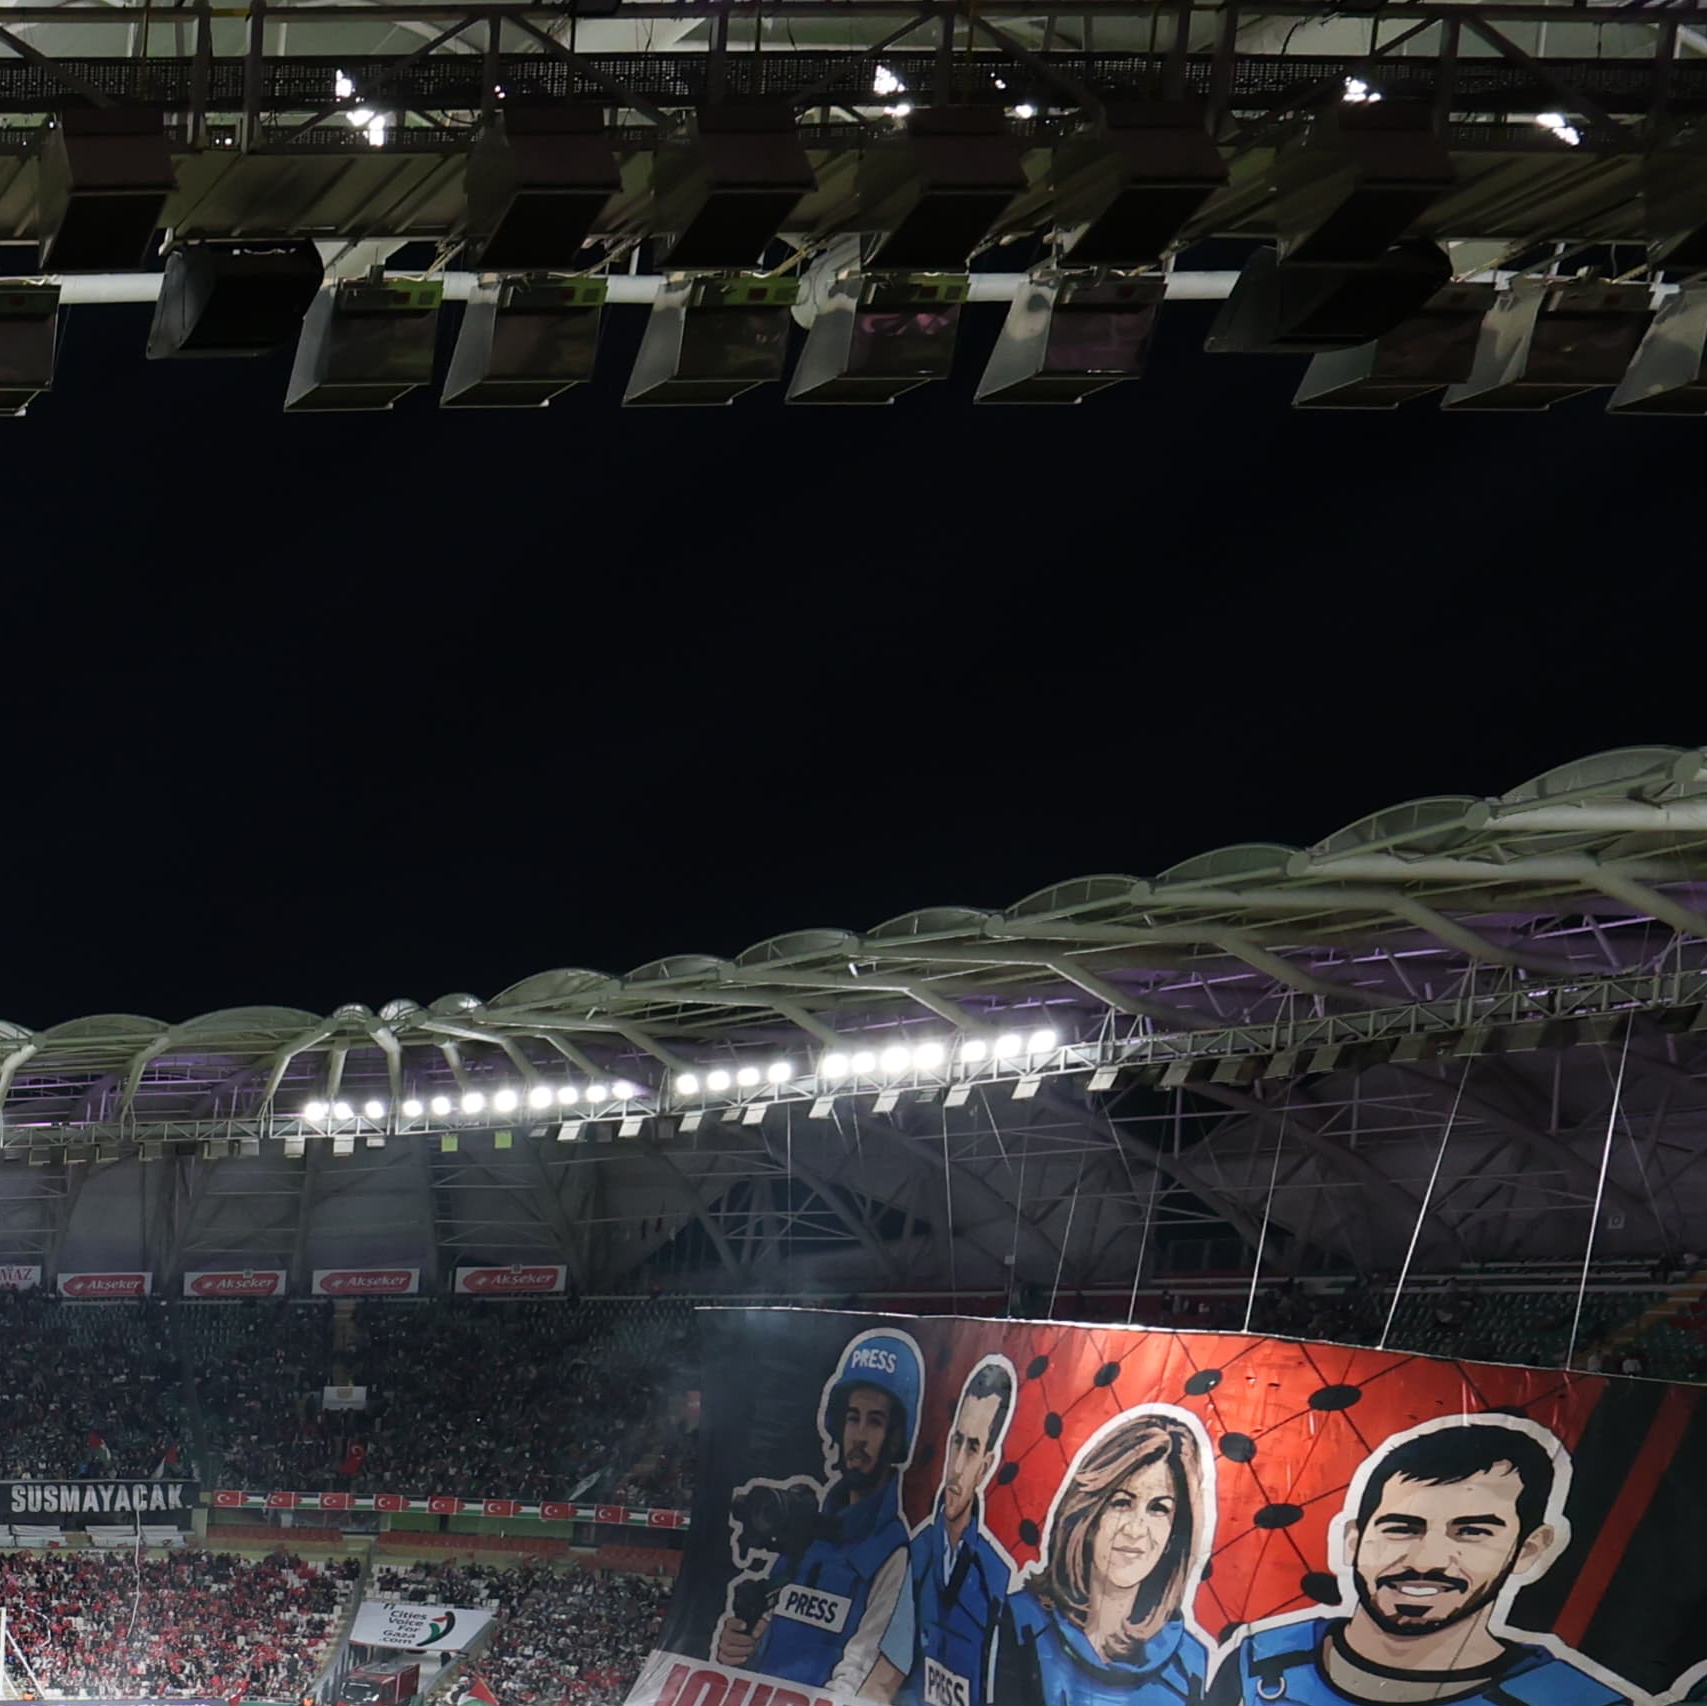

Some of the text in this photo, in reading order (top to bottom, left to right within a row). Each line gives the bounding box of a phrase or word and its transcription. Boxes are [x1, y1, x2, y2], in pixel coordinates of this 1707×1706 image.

[849, 1347, 898, 1375] PRESS
[391, 1609, 428, 1621] Cities
[787, 1587, 843, 1627] PRESS
